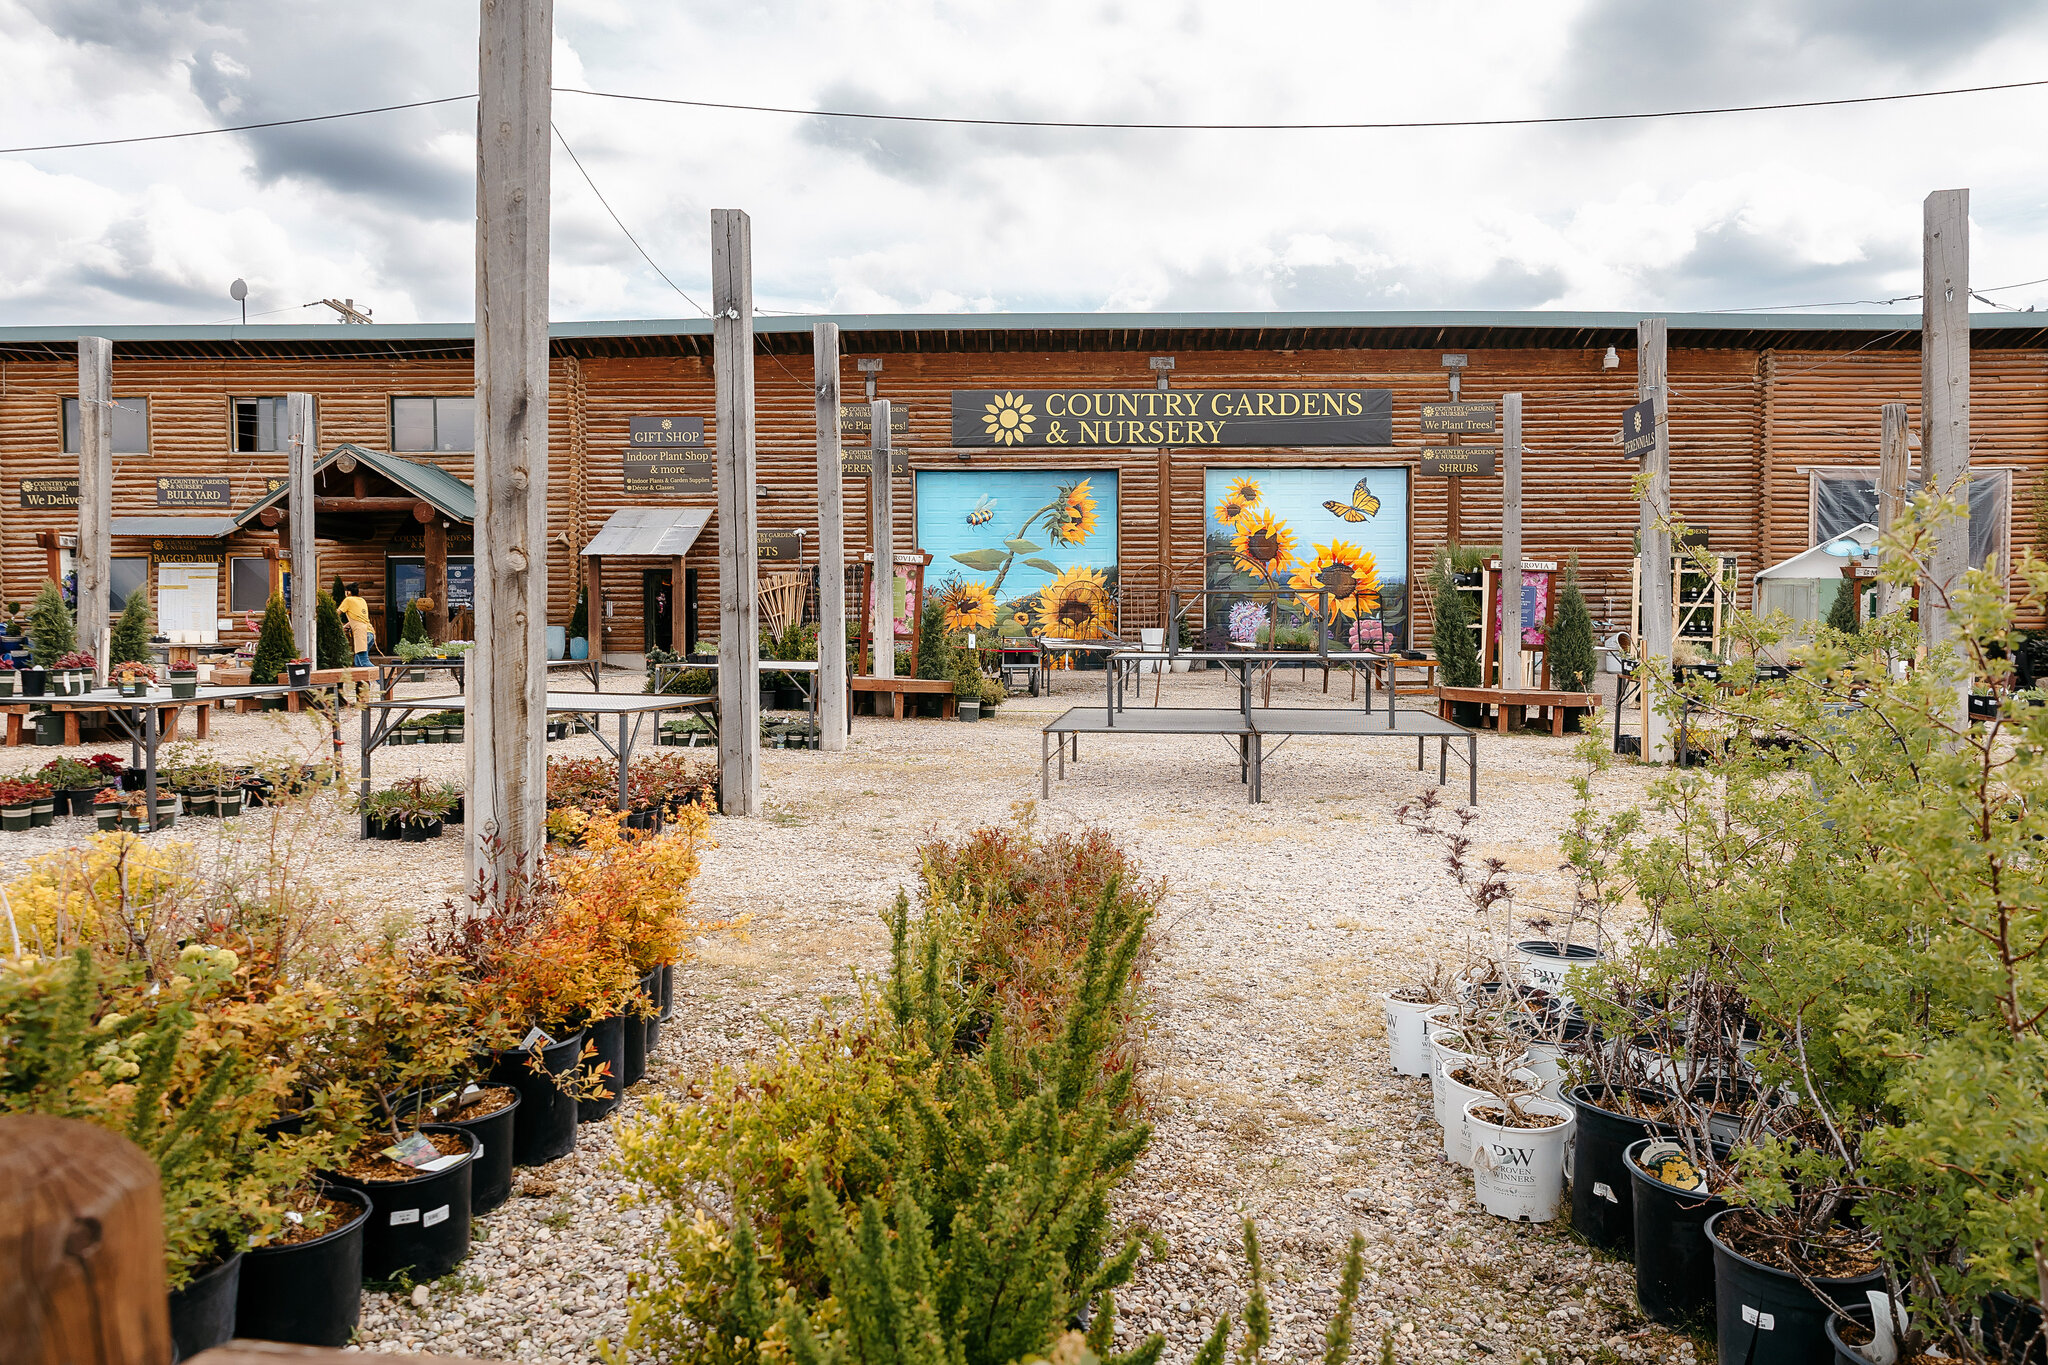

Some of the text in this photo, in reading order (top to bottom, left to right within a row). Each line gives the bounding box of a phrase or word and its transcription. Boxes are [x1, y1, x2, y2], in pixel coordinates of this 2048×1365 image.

[1045, 392, 1363, 417] COUNTRY GARDENS
[840, 421, 853, 430] We
[890, 421, 906, 430] ees!
[1425, 420, 1493, 430] We Plant Trees!
[634, 431, 700, 443] GIFT SHOP
[1045, 420, 1226, 444] & NURSERY
[1625, 432, 1655, 455] PERENNIALS
[626, 450, 709, 463] Indoor Plant Shop
[650, 464, 685, 474] & more
[842, 464, 903, 473] PERENLS
[1438, 463, 1479, 473] SHRUBS
[689, 476, 710, 484] Supplies
[27, 494, 80, 505] We Delive
[167, 490, 221, 500] BULK YARD
[758, 546, 778, 557] FTS
[153, 554, 224, 563] BAGGED/BULK
[1521, 561, 1550, 570] ROVIA
[1492, 1143, 1535, 1167] PW
[1500, 1166, 1532, 1176] ROVEN
[1492, 1170, 1535, 1183] WINNERS
